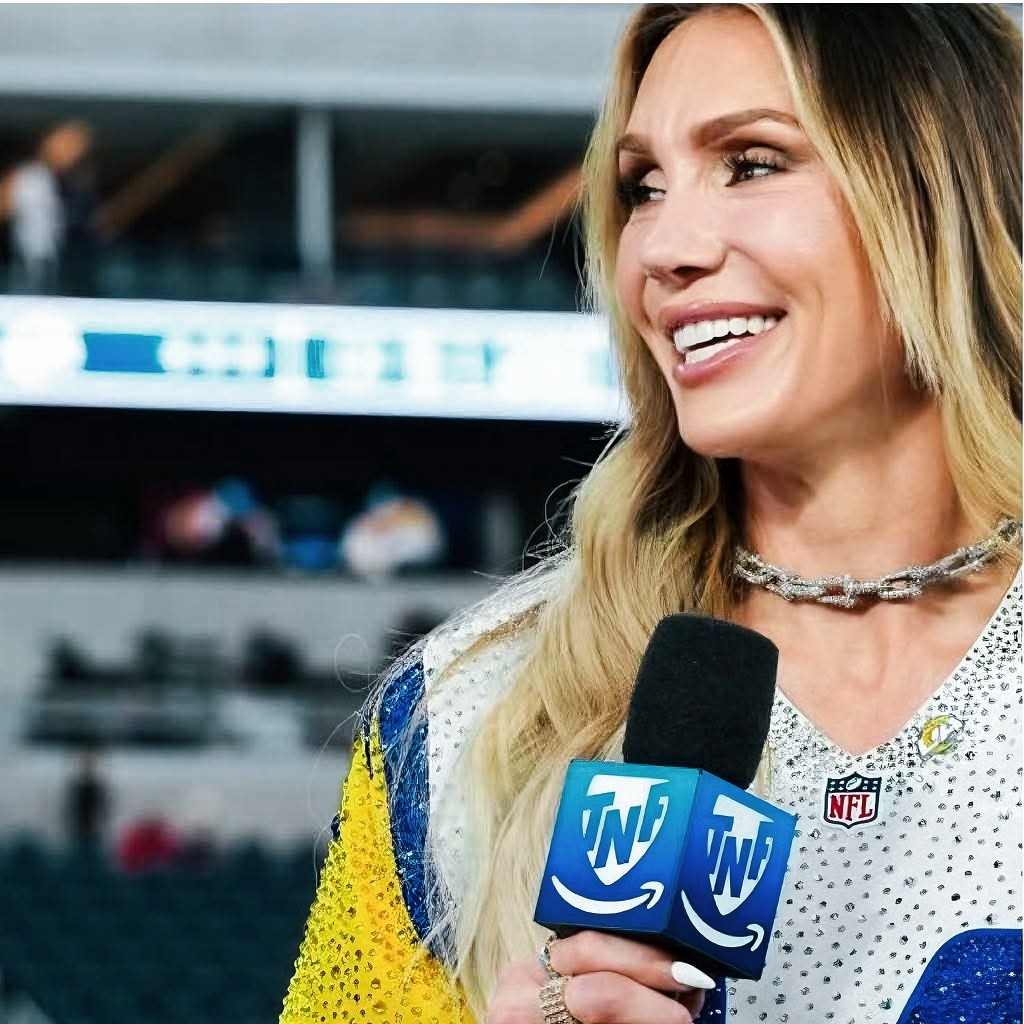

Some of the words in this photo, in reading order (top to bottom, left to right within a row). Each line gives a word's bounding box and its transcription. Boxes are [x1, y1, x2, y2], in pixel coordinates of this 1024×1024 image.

[582, 781, 670, 876] TNF
[829, 793, 873, 821] NFL
[707, 806, 776, 904] TNF
